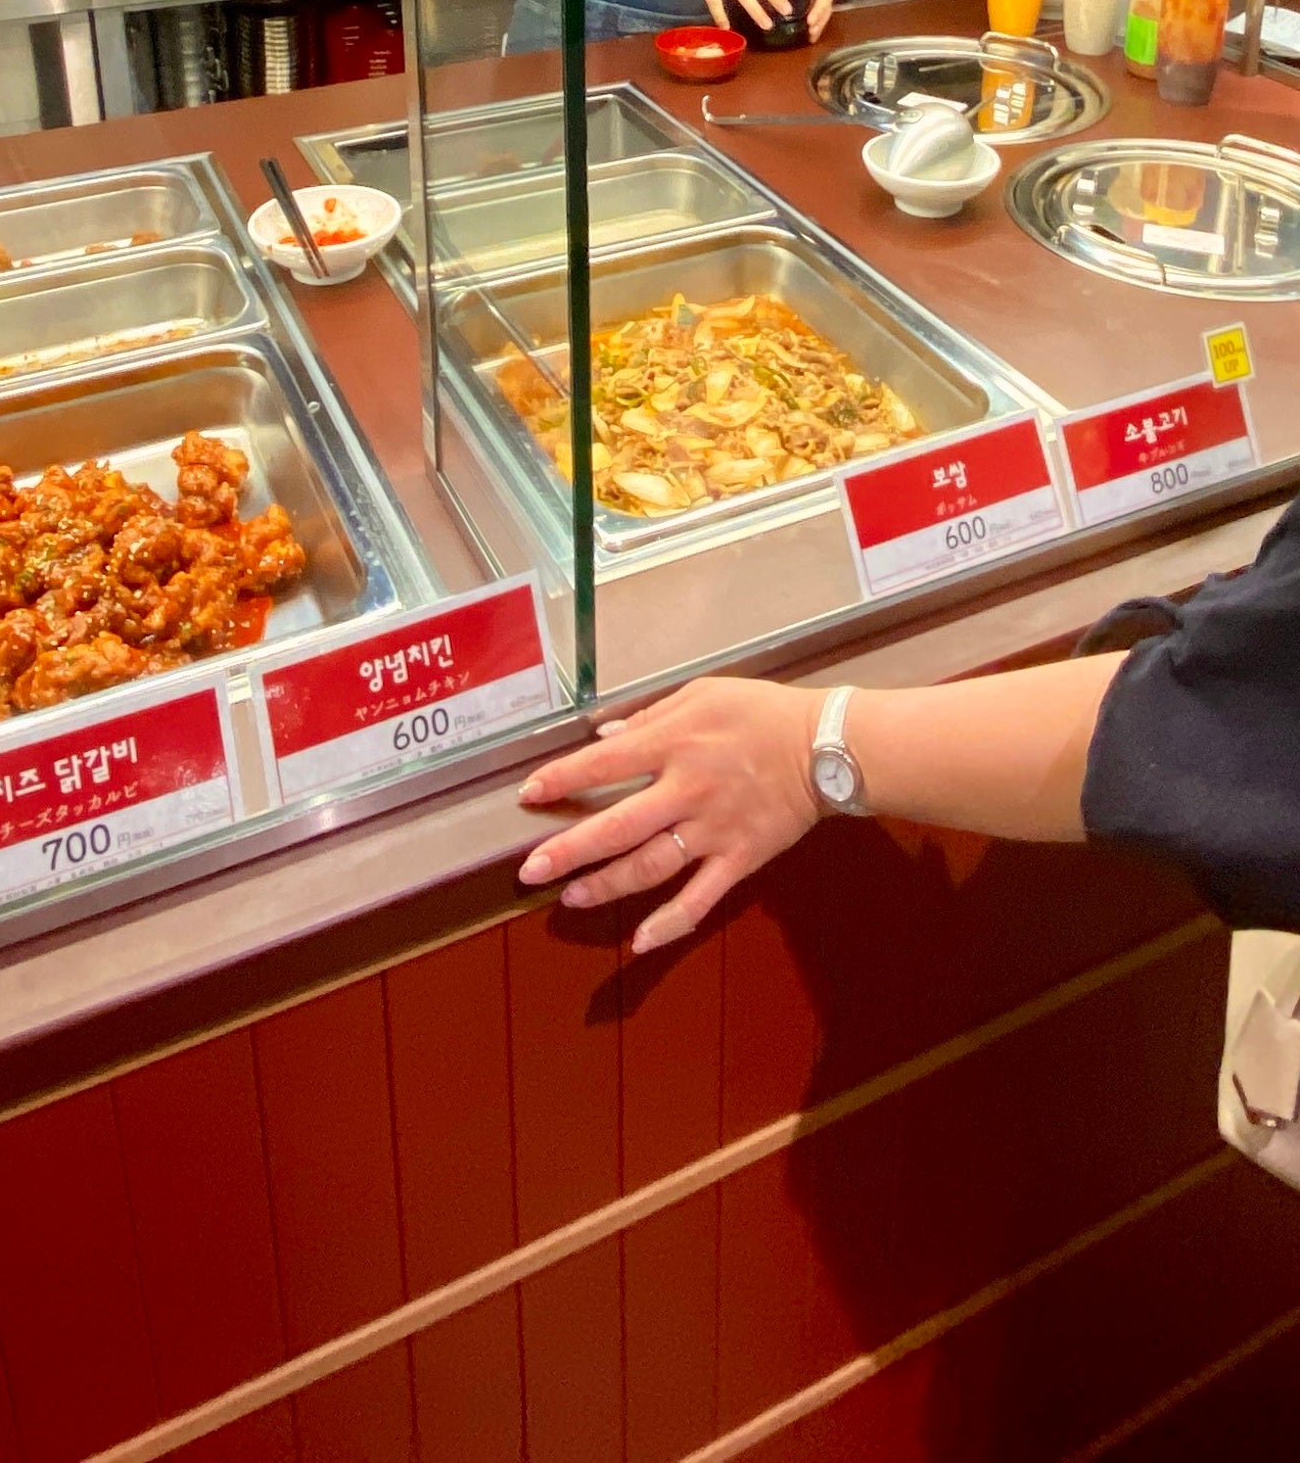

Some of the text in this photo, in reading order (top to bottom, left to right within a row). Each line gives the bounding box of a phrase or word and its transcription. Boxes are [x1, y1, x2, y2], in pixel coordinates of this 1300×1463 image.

[1212, 340, 1235, 360] 100
[1124, 405, 1189, 444] 소불고기
[1150, 463, 1189, 494] 800
[945, 515, 986, 550] 600
[359, 634, 454, 693] 양념치킨
[392, 707, 450, 751] 600
[54, 736, 139, 795] 닭갈비
[41, 824, 112, 872] 700
